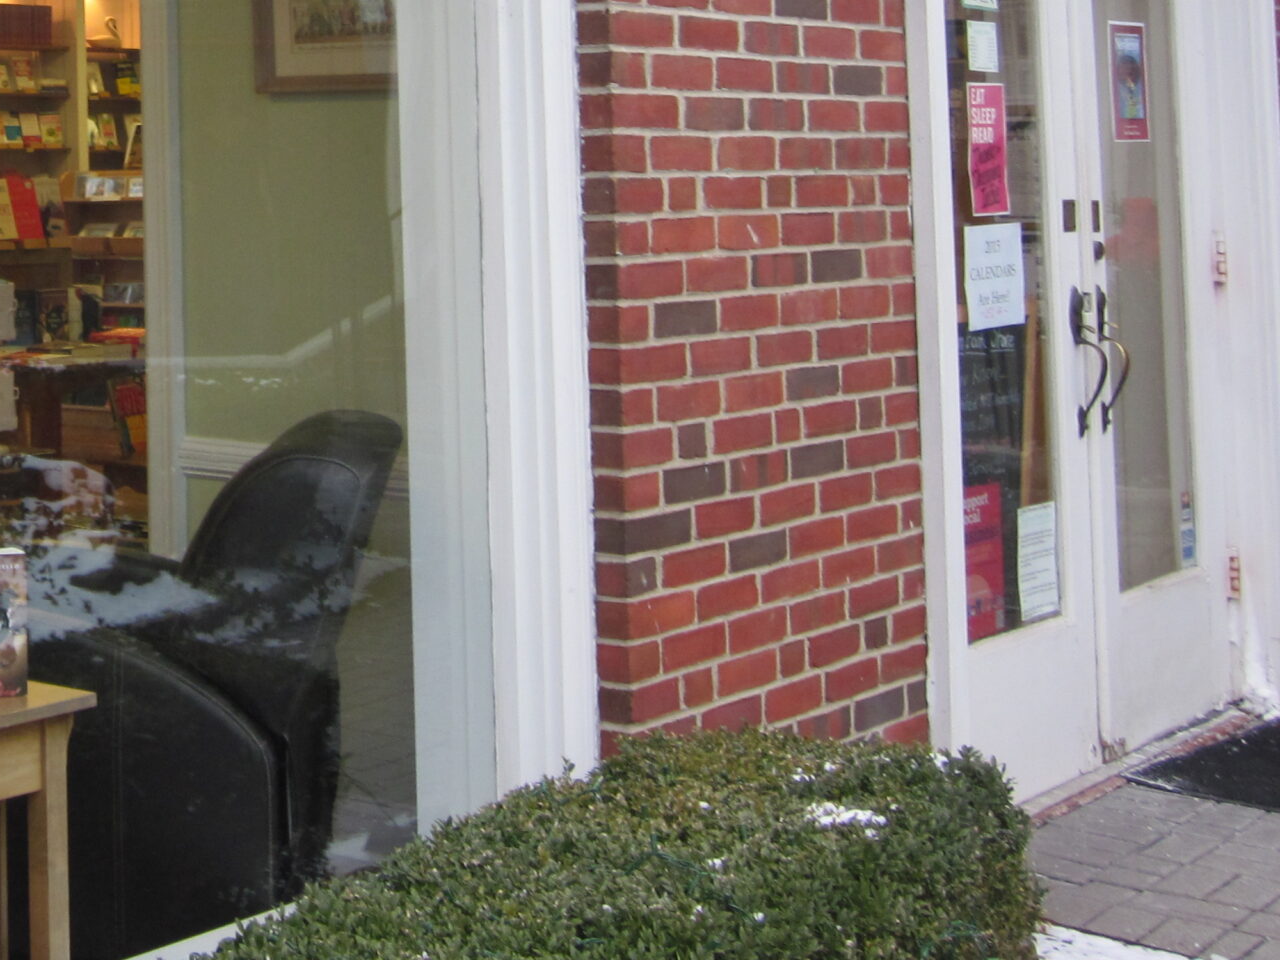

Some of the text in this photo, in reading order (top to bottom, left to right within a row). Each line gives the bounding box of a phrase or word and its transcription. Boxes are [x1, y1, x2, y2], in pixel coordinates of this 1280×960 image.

[970, 87, 986, 105] EAT
[971, 107, 997, 125] SLEEP
[971, 126, 995, 144] READ
